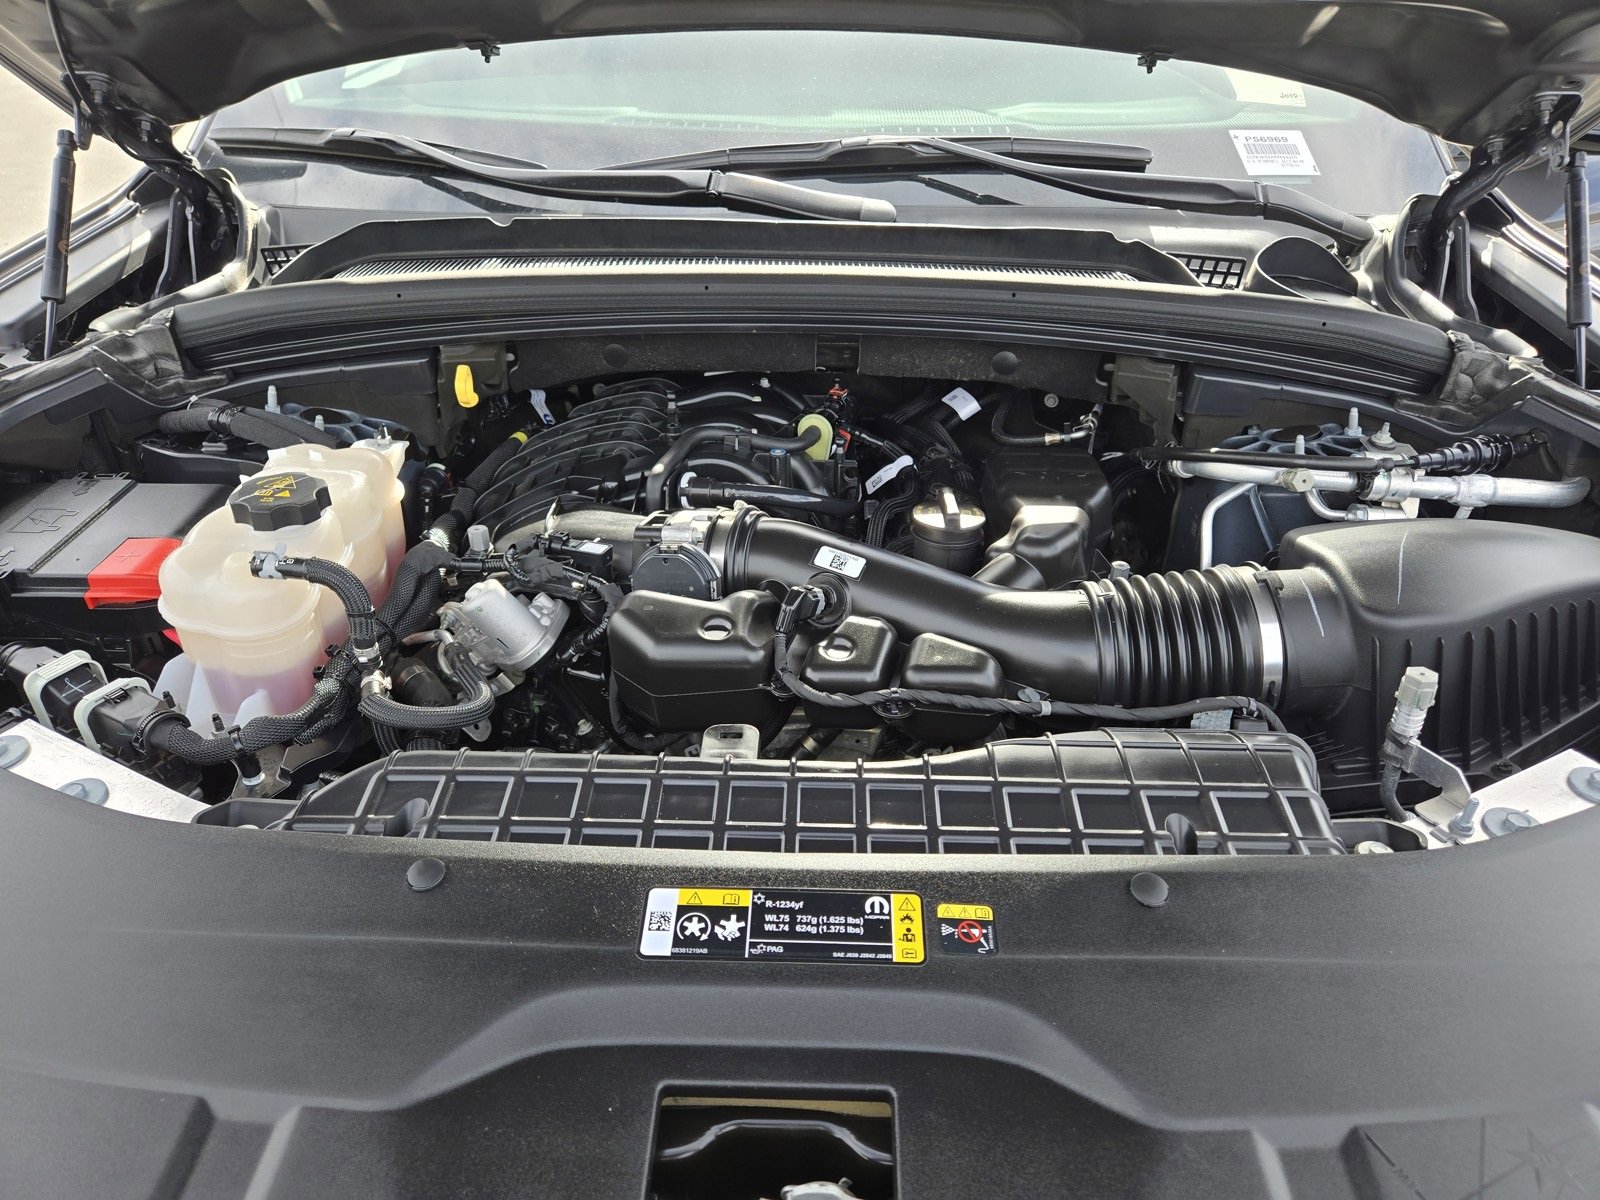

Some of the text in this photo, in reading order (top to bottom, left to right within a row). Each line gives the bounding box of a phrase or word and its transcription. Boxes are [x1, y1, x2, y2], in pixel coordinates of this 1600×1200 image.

[765, 900, 804, 910] R-1234yf
[764, 914, 864, 926] WL75 737g (1.625 lbs)
[764, 923, 864, 936] WL74 624g (1.375 lbs)
[766, 945, 784, 953] PAG
